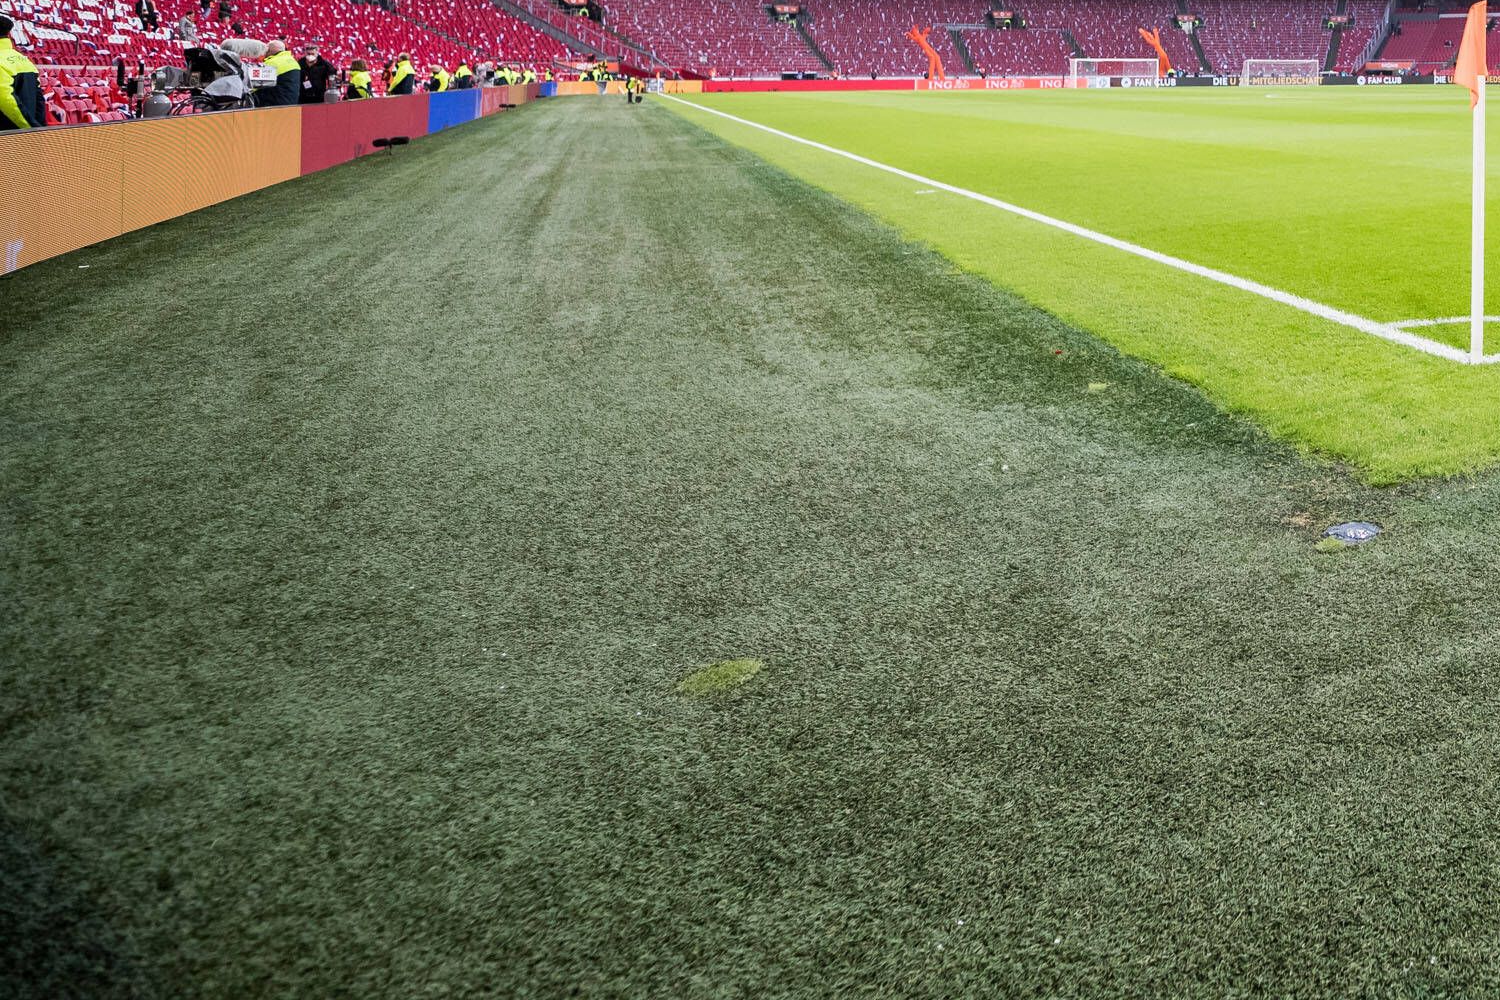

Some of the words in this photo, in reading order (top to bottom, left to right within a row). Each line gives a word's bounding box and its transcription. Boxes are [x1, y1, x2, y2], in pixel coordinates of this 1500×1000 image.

[985, 80, 1009, 88] ING
[1040, 80, 1063, 88] ING
[1134, 78, 1152, 87] FAN
[1213, 77, 1228, 86] DIE
[1229, 77, 1237, 85] U
[1367, 76, 1382, 84] FAN
[1383, 76, 1402, 84] CLUB
[928, 80, 953, 89] ING
